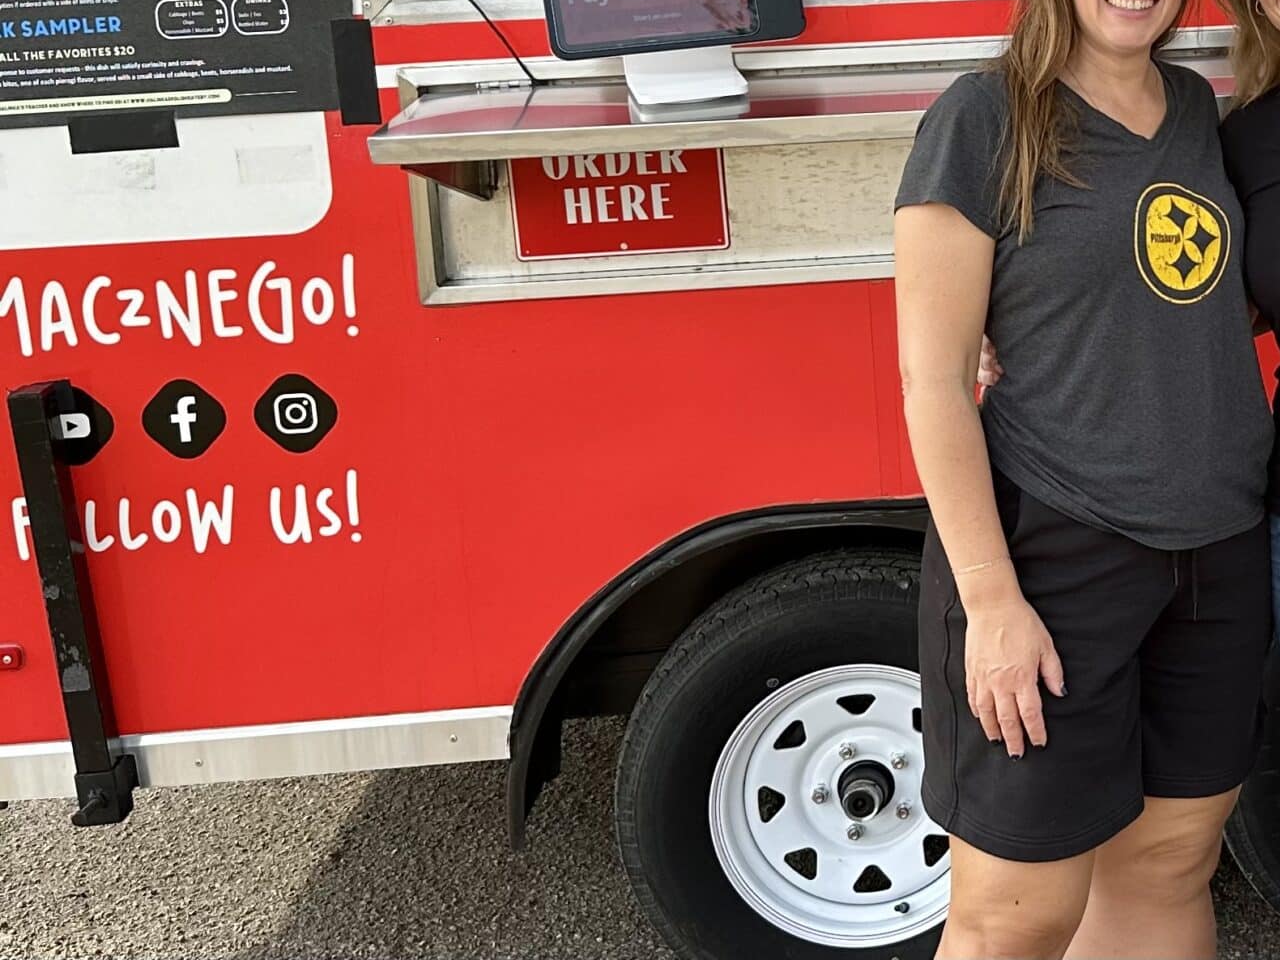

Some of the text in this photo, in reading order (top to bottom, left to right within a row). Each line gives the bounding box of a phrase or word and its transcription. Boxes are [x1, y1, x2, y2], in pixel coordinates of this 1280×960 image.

[21, 16, 121, 38] SAMPLER
[23, 50, 46, 61] THE
[48, 47, 111, 59] FAVORITES
[113, 46, 135, 56] $20
[542, 149, 688, 180] ORDER
[564, 183, 674, 224] HERE
